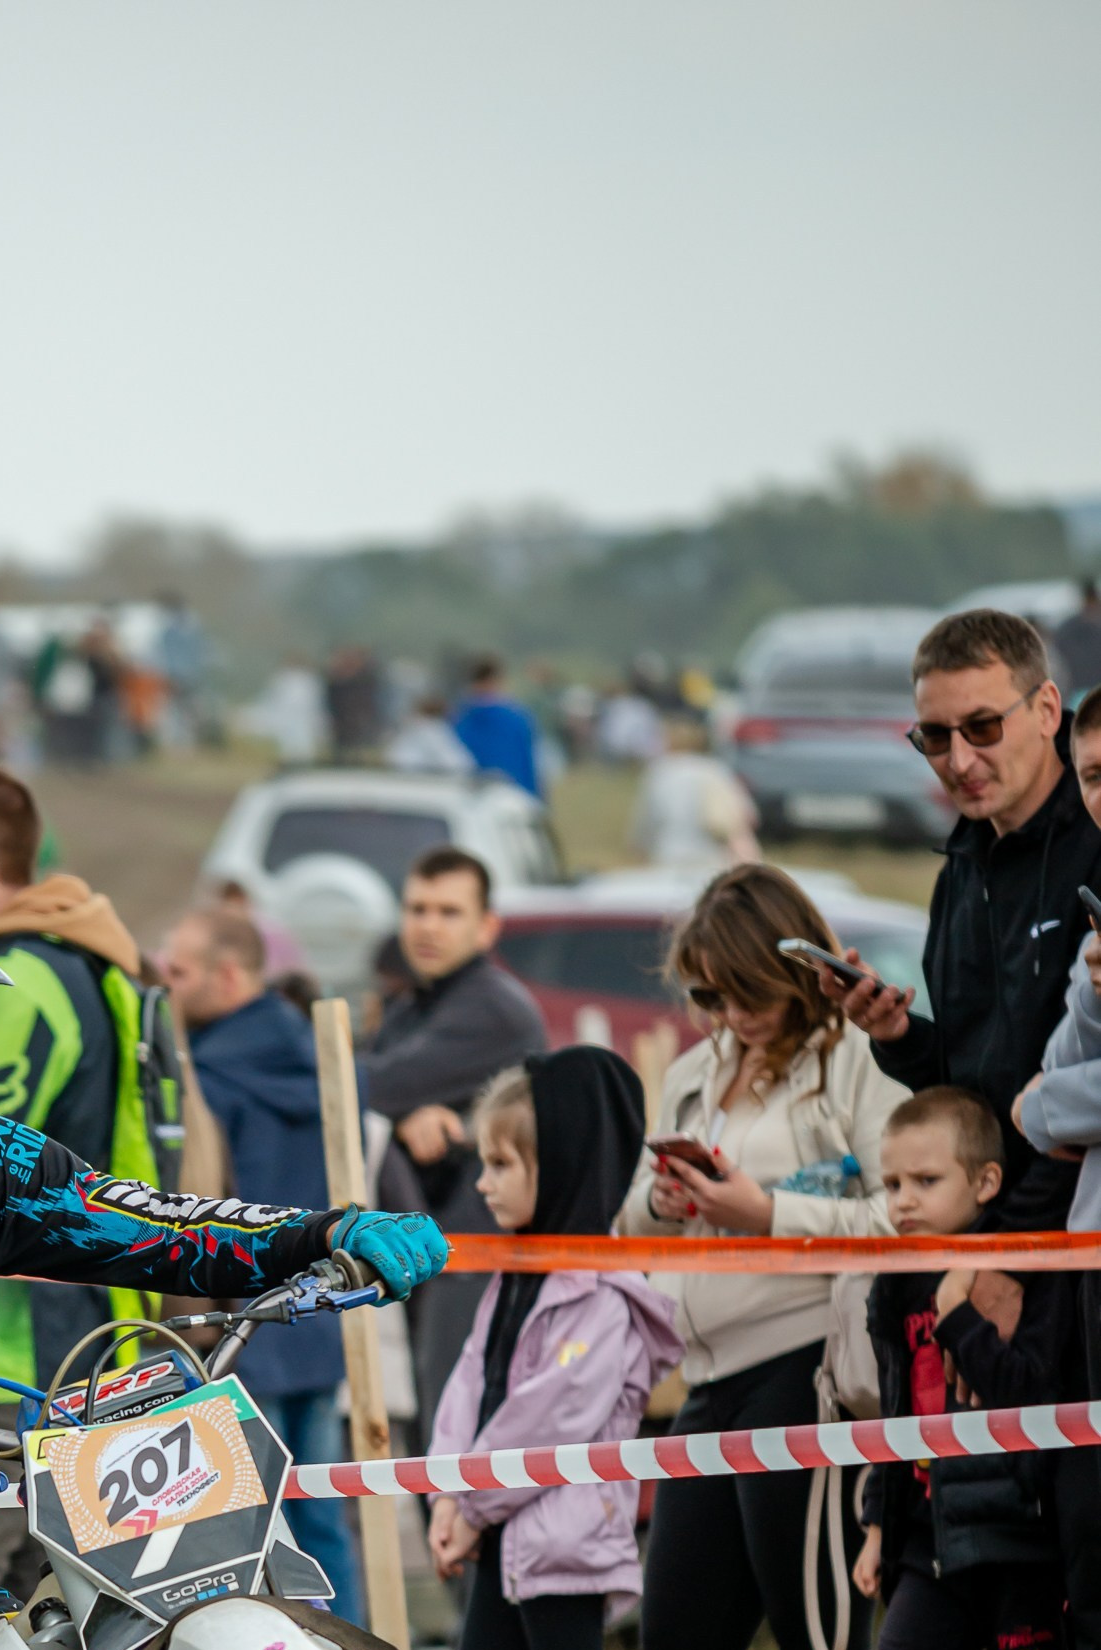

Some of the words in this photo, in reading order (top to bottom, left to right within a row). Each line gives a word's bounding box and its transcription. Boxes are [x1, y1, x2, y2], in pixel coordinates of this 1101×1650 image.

[6, 1124, 47, 1169] RID
[9, 1163, 32, 1185] the
[50, 1361, 174, 1421] WRP
[93, 1393, 174, 1426] racing.com
[99, 1421, 191, 1528] 207
[152, 1466, 202, 1506] СЛОБОДСКАЯ
[162, 1572, 236, 1602] GoPro
